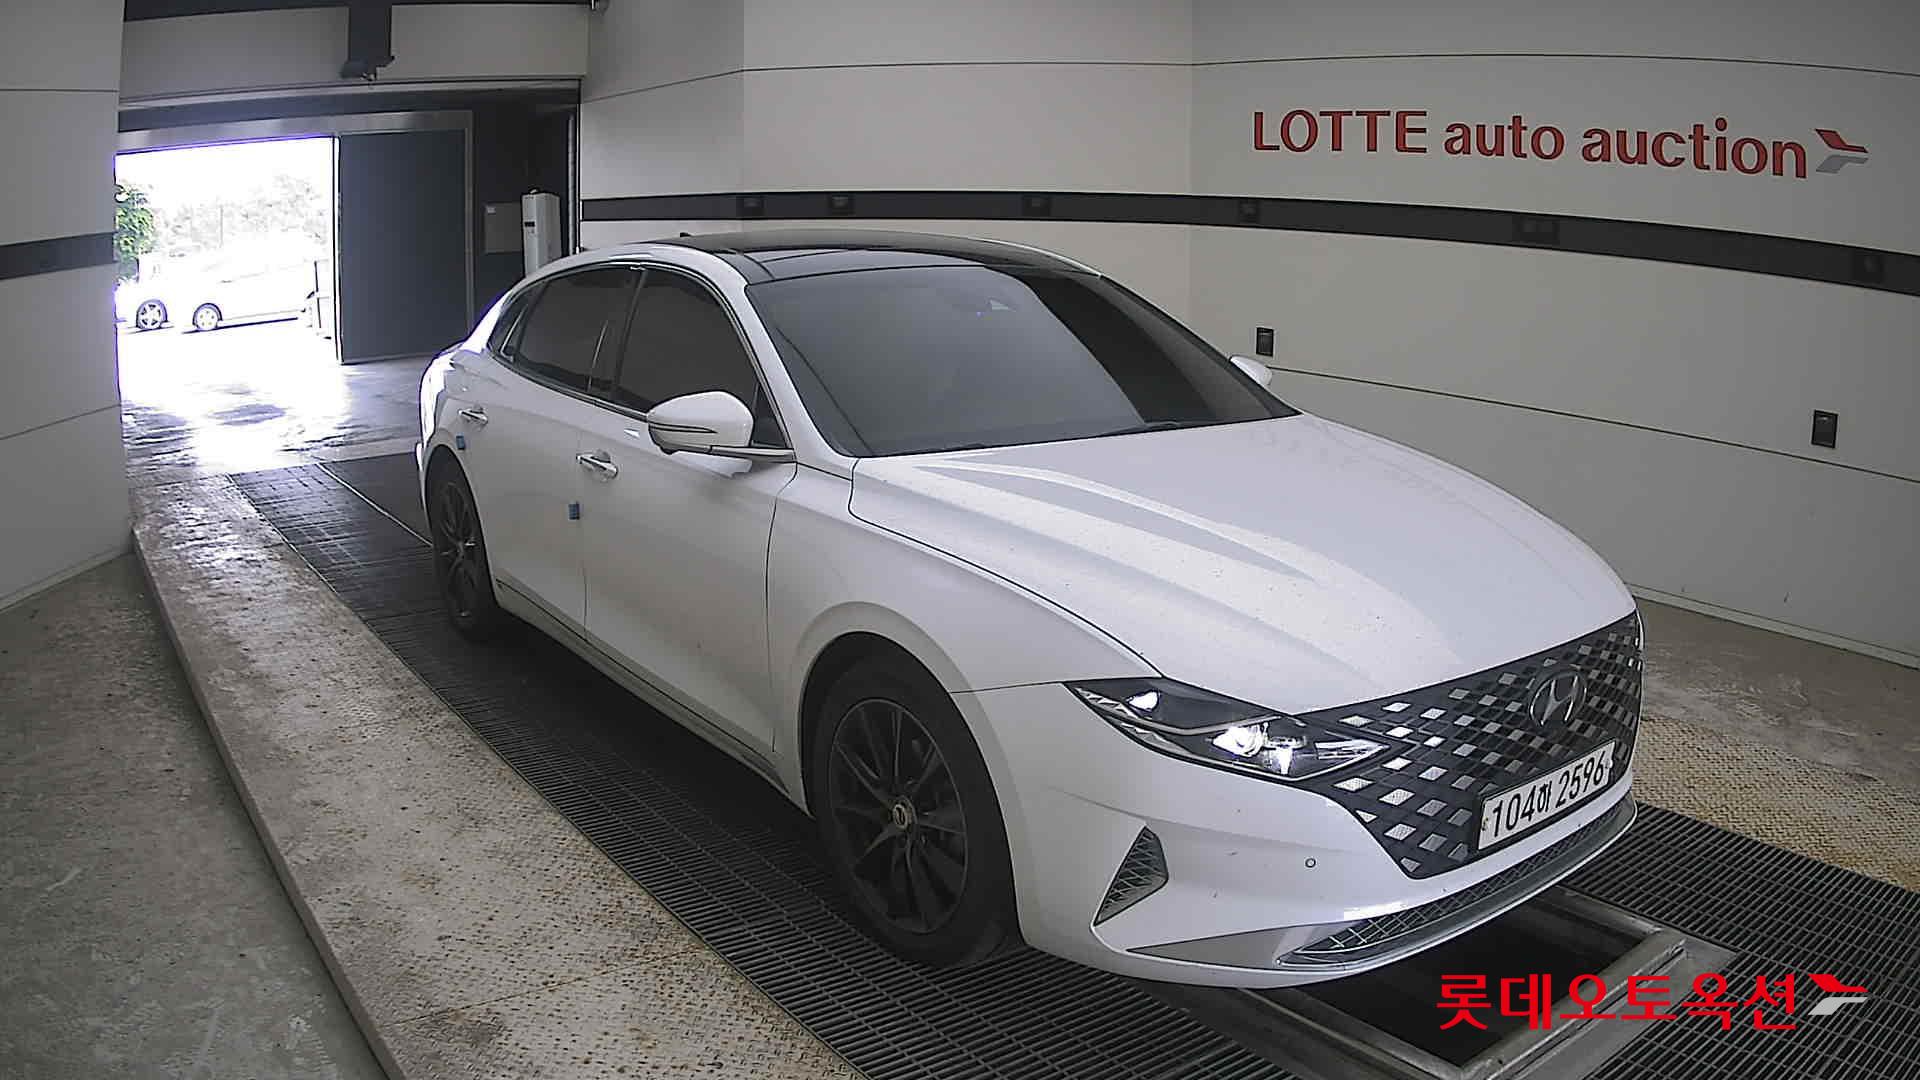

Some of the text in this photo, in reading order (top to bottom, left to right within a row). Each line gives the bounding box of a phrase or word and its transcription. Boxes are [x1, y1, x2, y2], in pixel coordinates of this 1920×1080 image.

[1253, 110, 1808, 179] LOTTE auto auction
[1555, 750, 1606, 809] 2596
